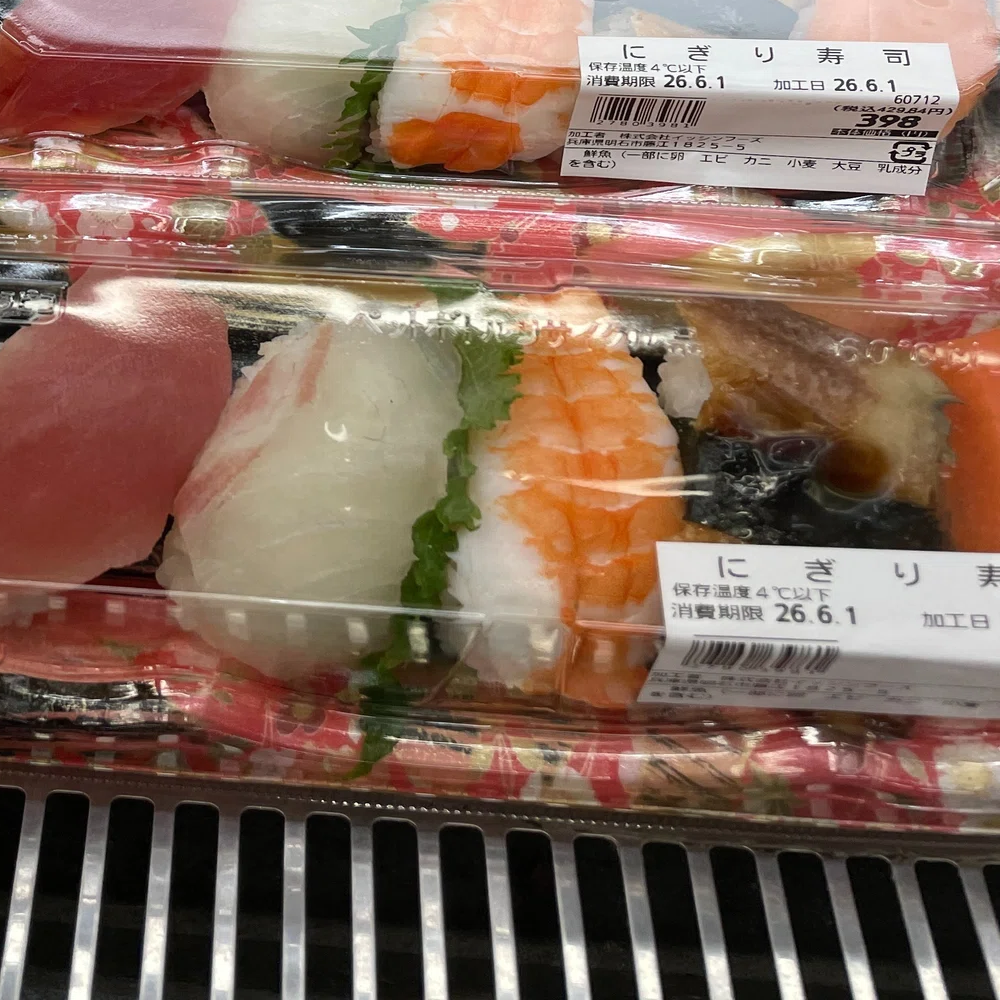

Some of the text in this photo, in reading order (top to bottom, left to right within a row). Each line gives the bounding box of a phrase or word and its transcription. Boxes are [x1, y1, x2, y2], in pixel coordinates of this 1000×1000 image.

[623, 45, 911, 66] にぎり寿司
[588, 63, 707, 73] 保存温度4℃以下
[586, 74, 897, 92] 消費期限 26.6.1 加工日 26.6.1
[893, 95, 941, 105] 60712
[853, 114, 922, 128] 398
[568, 131, 606, 139] 加工者
[569, 159, 617, 169] を含む)
[582, 150, 612, 159] 鮮魚
[701, 154, 728, 164] エビ
[744, 156, 772, 166] カニ
[787, 158, 817, 169] 小麦
[832, 161, 862, 172] 大豆
[877, 164, 923, 175] 乳成分
[672, 583, 831, 601] 保存温度4℃以下
[671, 603, 990, 629] 消費期限 26.6.1 加工日
